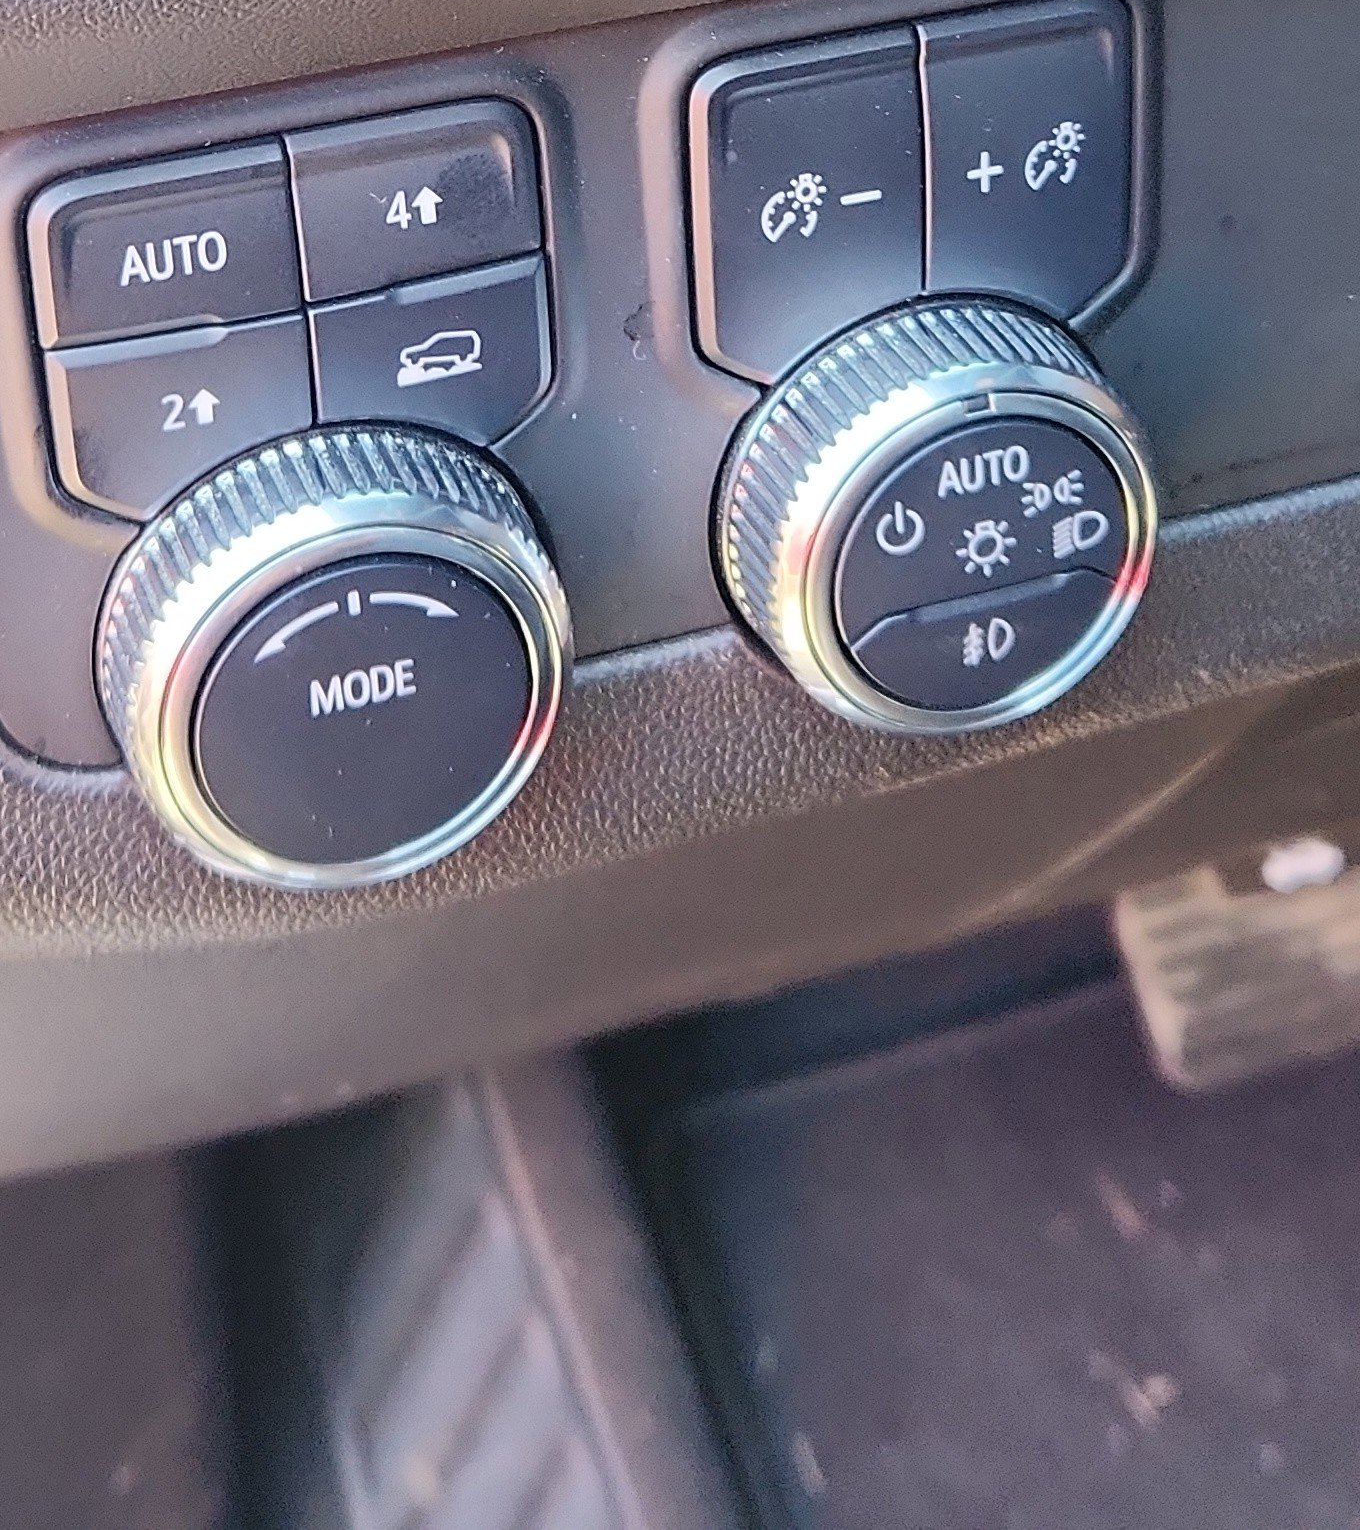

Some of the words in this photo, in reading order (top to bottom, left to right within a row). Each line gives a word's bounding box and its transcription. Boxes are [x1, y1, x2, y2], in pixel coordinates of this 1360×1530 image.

[386, 190, 412, 228] 4
[120, 231, 227, 286] AUTO
[160, 393, 187, 431] 2
[938, 444, 1029, 498] AUTO
[310, 658, 416, 716] MODE
